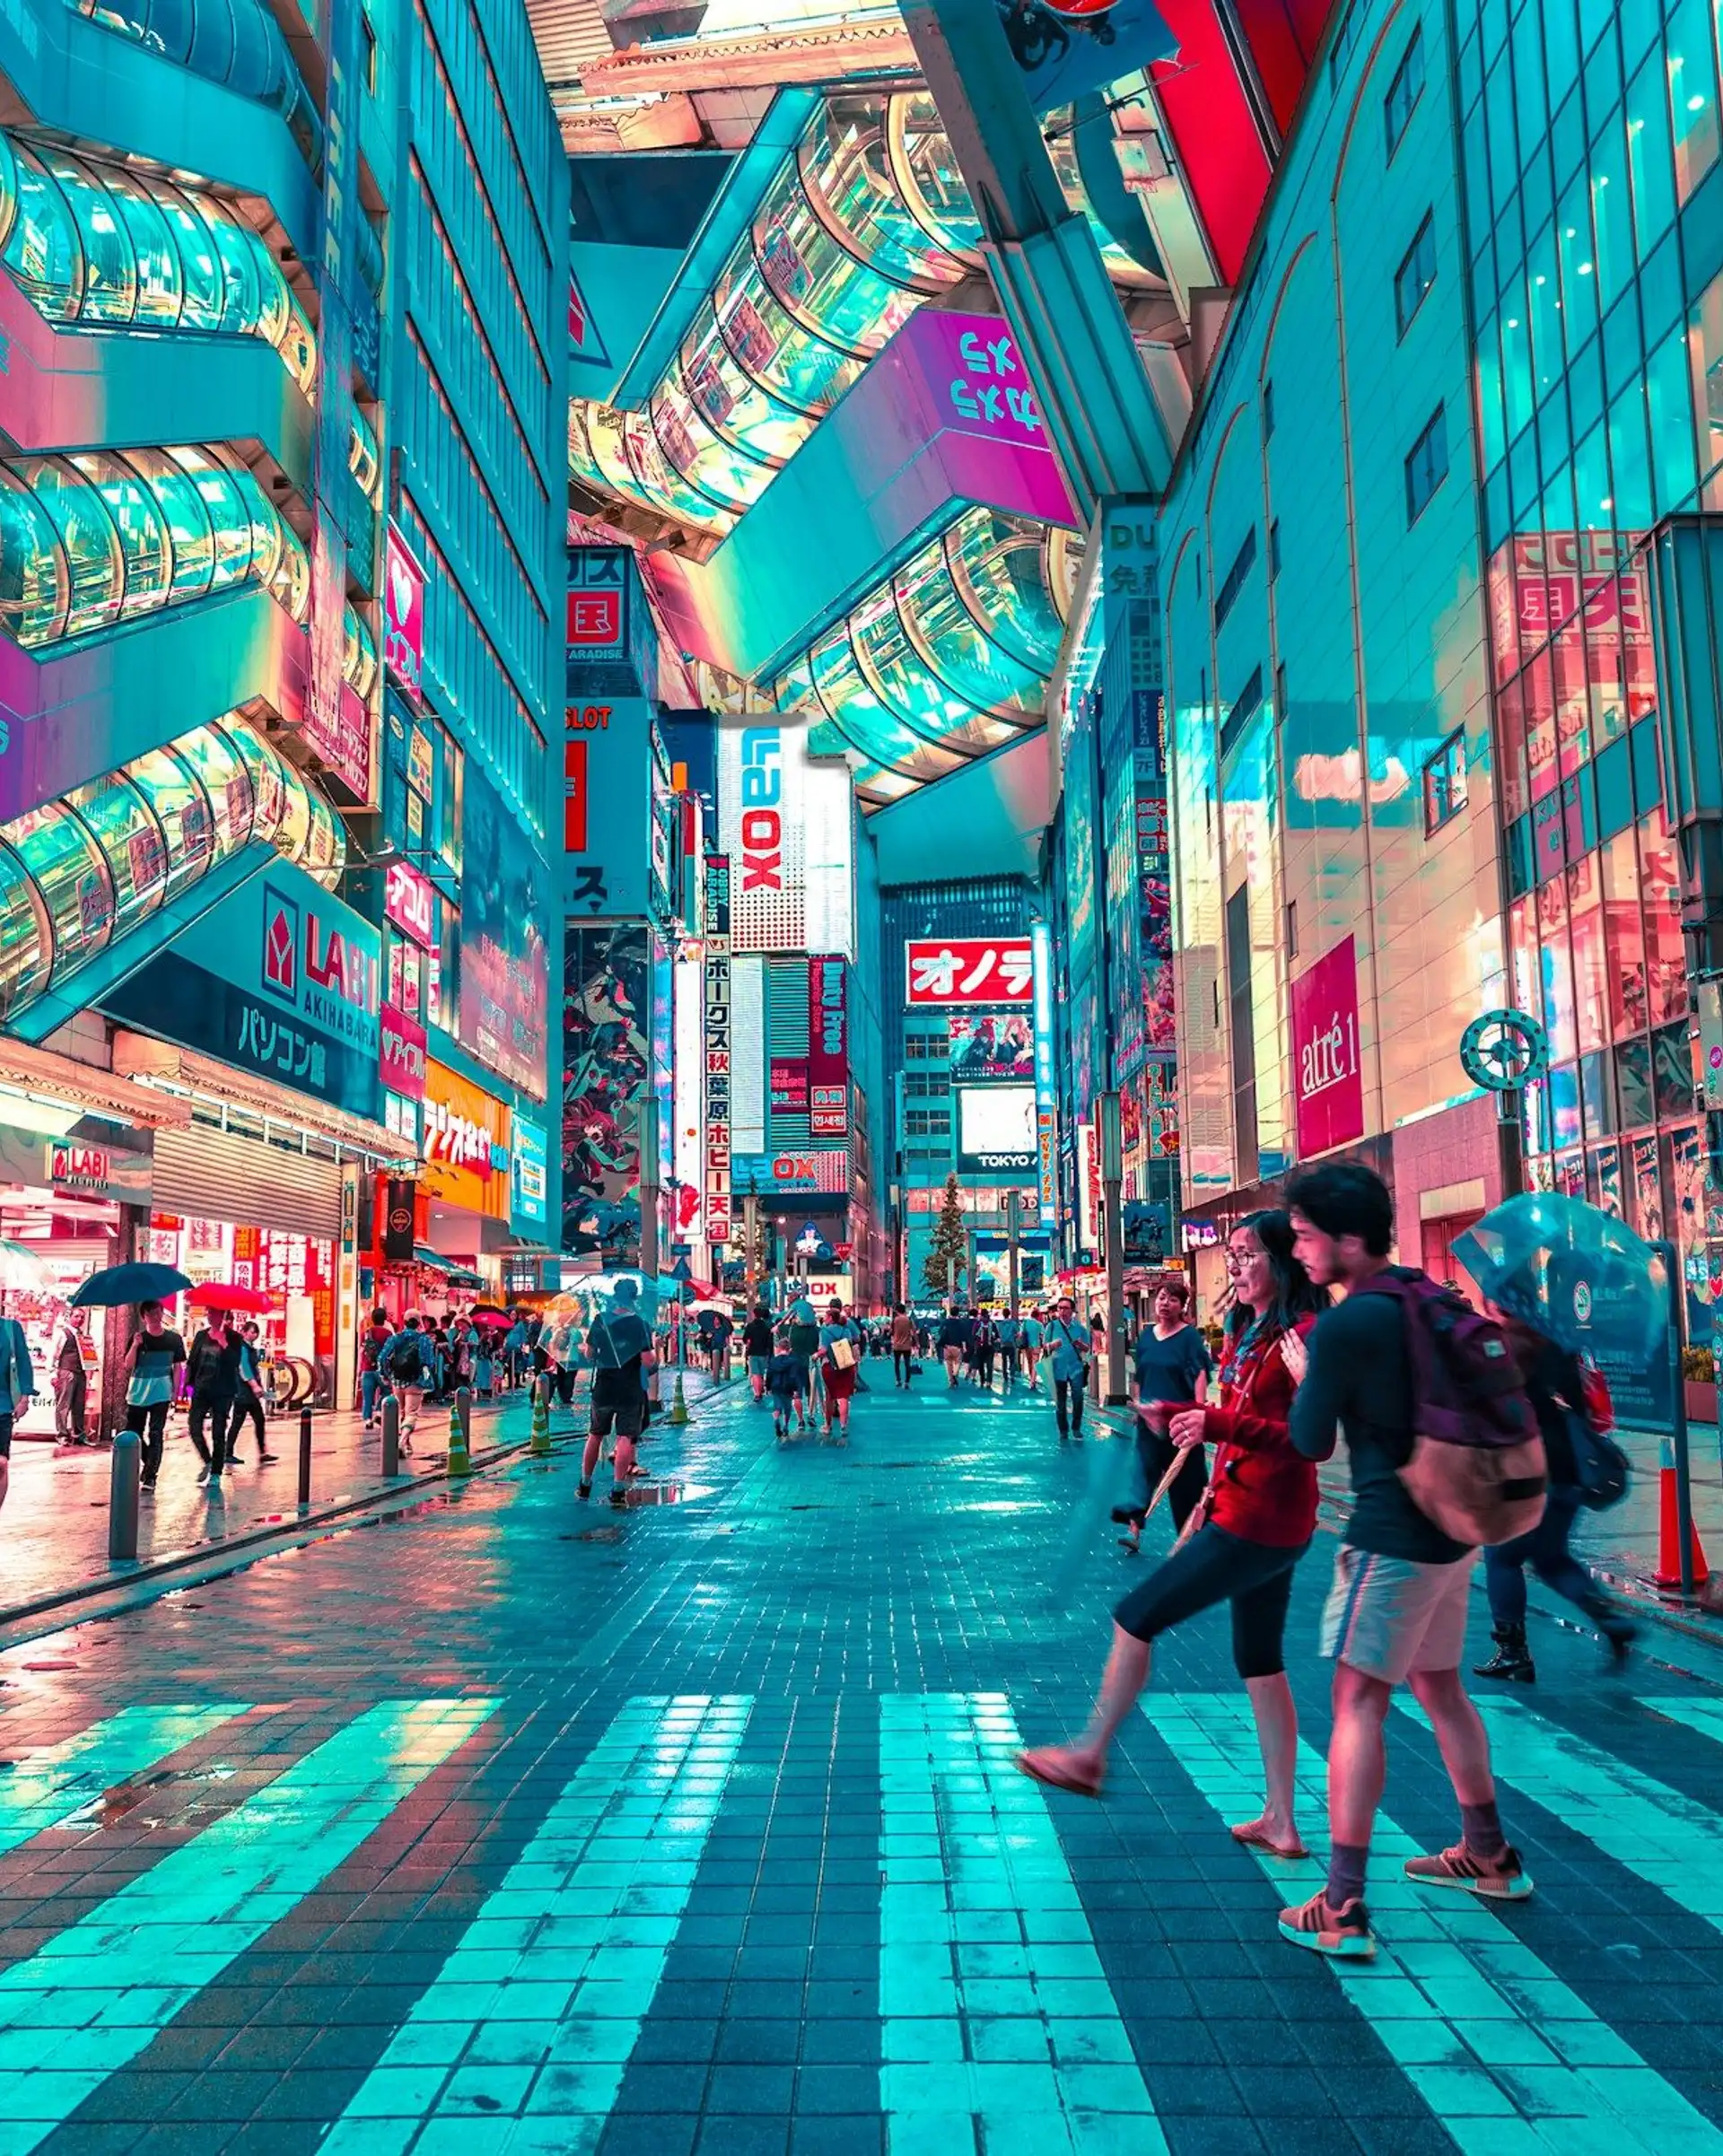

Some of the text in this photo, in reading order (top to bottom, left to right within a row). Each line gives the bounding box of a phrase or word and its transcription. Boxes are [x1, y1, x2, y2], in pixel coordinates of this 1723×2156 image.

[306, 912, 378, 1017] LABI
[304, 991, 378, 1050] AKIHABARA
[1302, 1010, 1344, 1094] atré
[72, 1148, 108, 1178] LABI
[977, 1155, 1029, 1167] TOKYO
